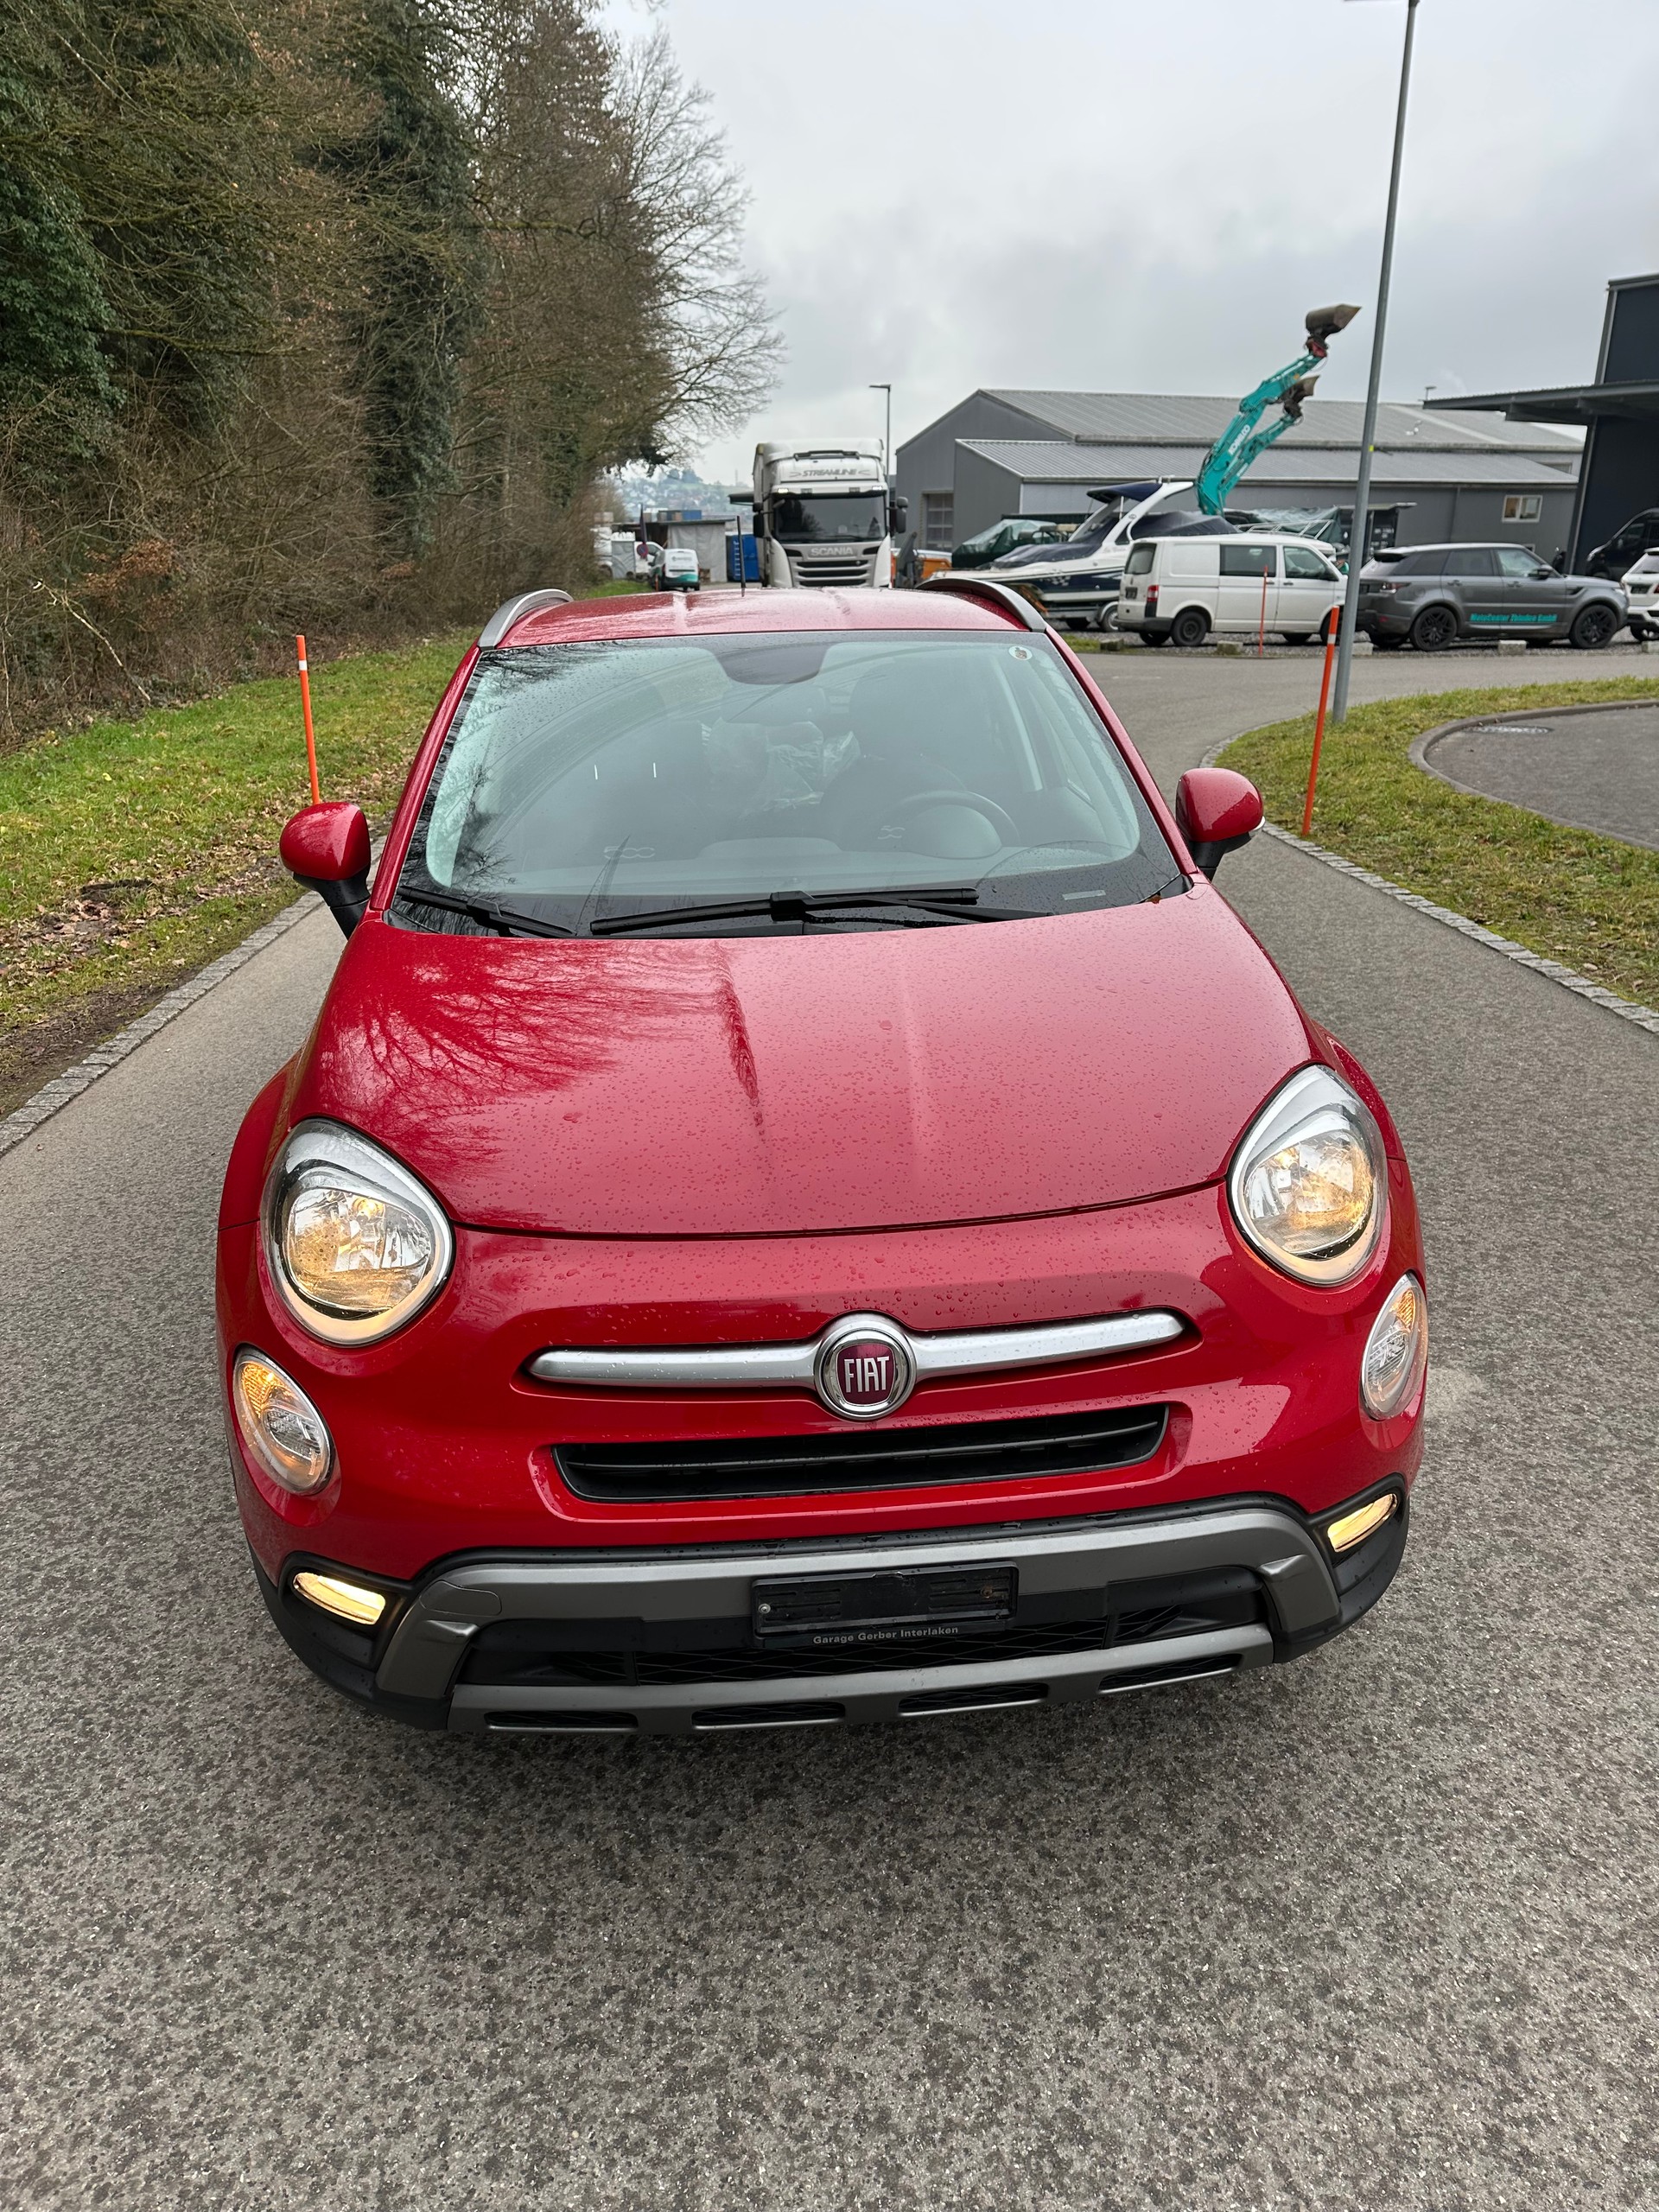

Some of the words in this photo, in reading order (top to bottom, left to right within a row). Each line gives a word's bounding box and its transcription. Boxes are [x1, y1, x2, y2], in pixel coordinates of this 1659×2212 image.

[802, 468, 857, 477] STREAMLINE
[810, 546, 854, 556] SCANIA
[843, 1356, 890, 1393] FIAT
[812, 1635, 855, 1644] Garage
[857, 1630, 897, 1641] Gerber
[900, 1626, 958, 1637] Interlaken
